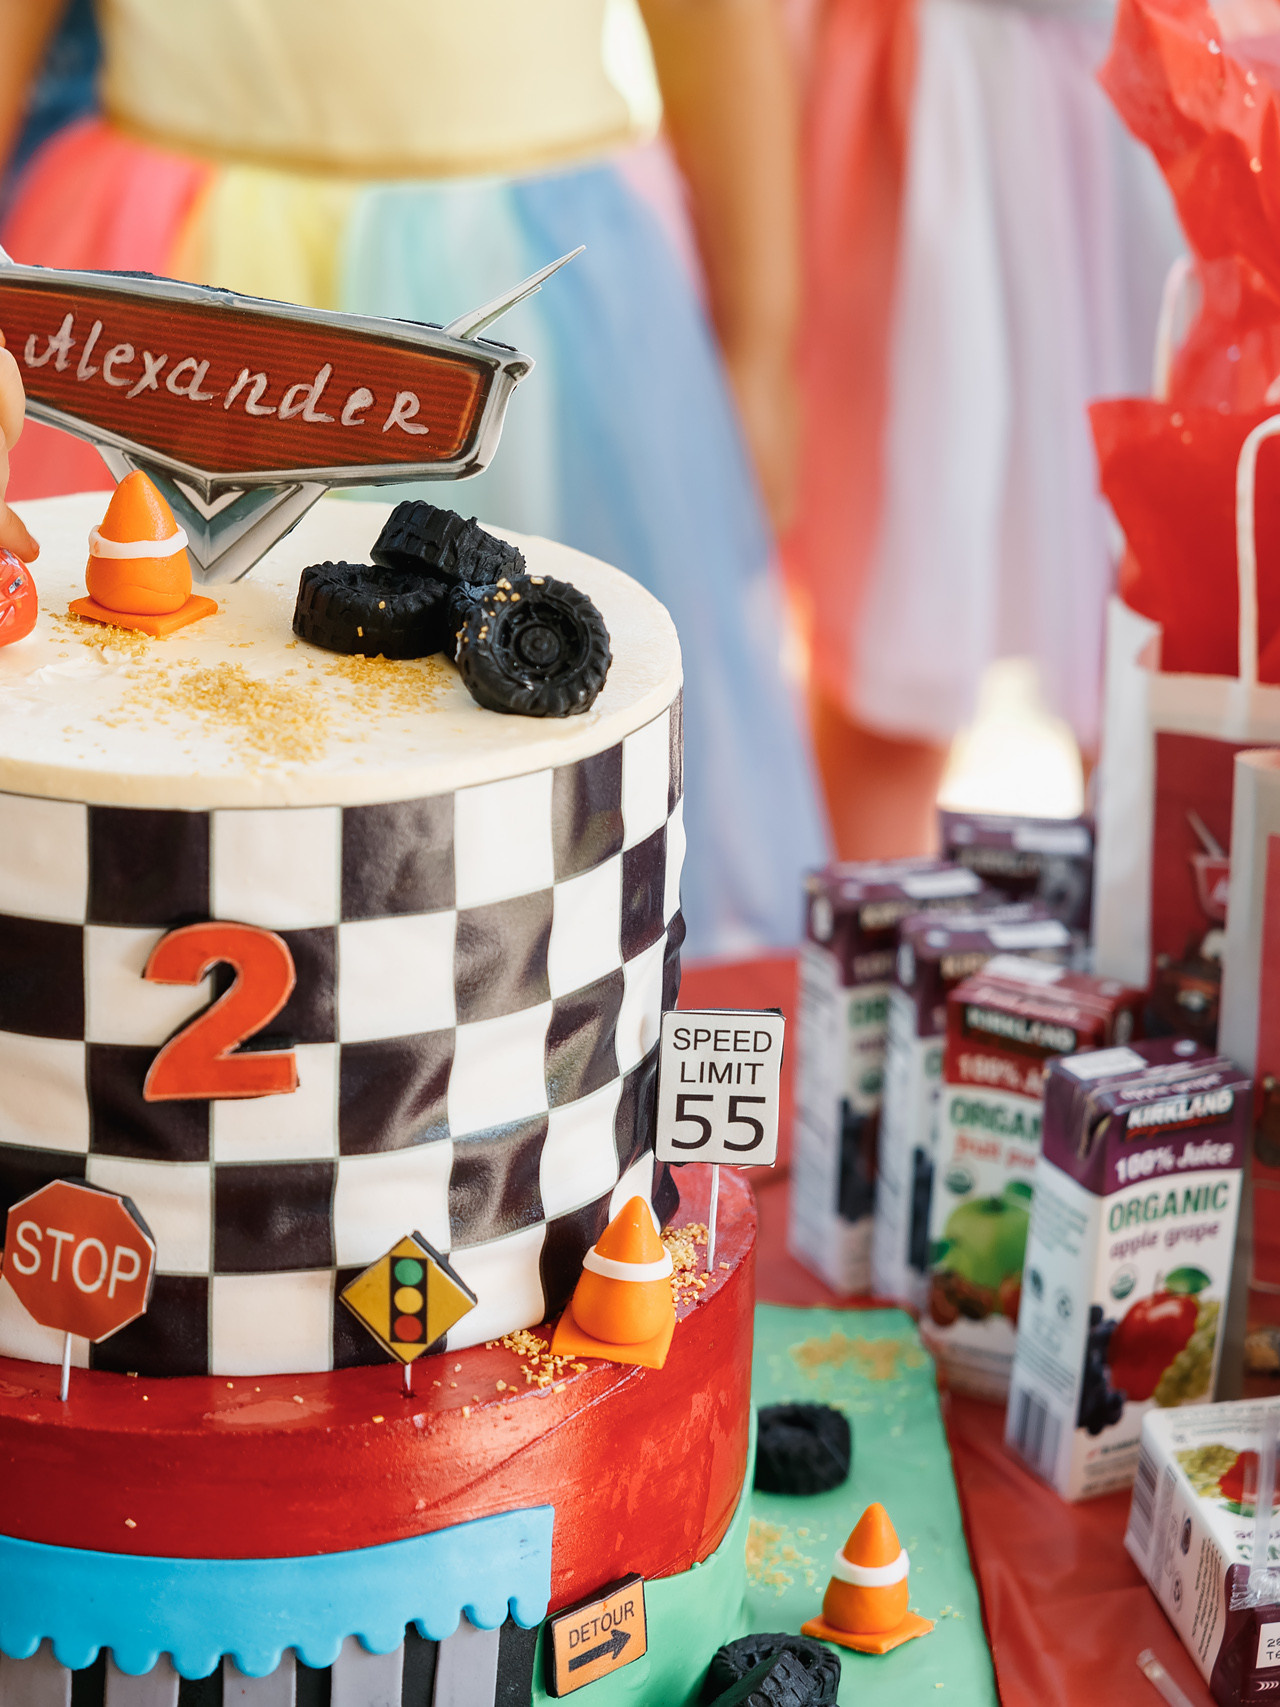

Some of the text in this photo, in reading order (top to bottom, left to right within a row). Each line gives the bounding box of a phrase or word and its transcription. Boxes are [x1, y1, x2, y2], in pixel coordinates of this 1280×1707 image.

[143, 921, 299, 1102] 2
[966, 1007, 1077, 1053] KIRKLAND
[672, 1028, 772, 1053] SPEED
[680, 1061, 764, 1085] LIMIT
[671, 1094, 766, 1151] 55
[951, 1096, 1042, 1142] ORGAN
[1127, 1089, 1234, 1129] KIRKLAND
[1115, 1140, 1234, 1184] 100% Juice
[1108, 1182, 1230, 1235] ORGANIC
[12, 1221, 141, 1299] STOP
[1109, 1221, 1220, 1262] apple grape
[569, 1600, 635, 1649] DETOUR
